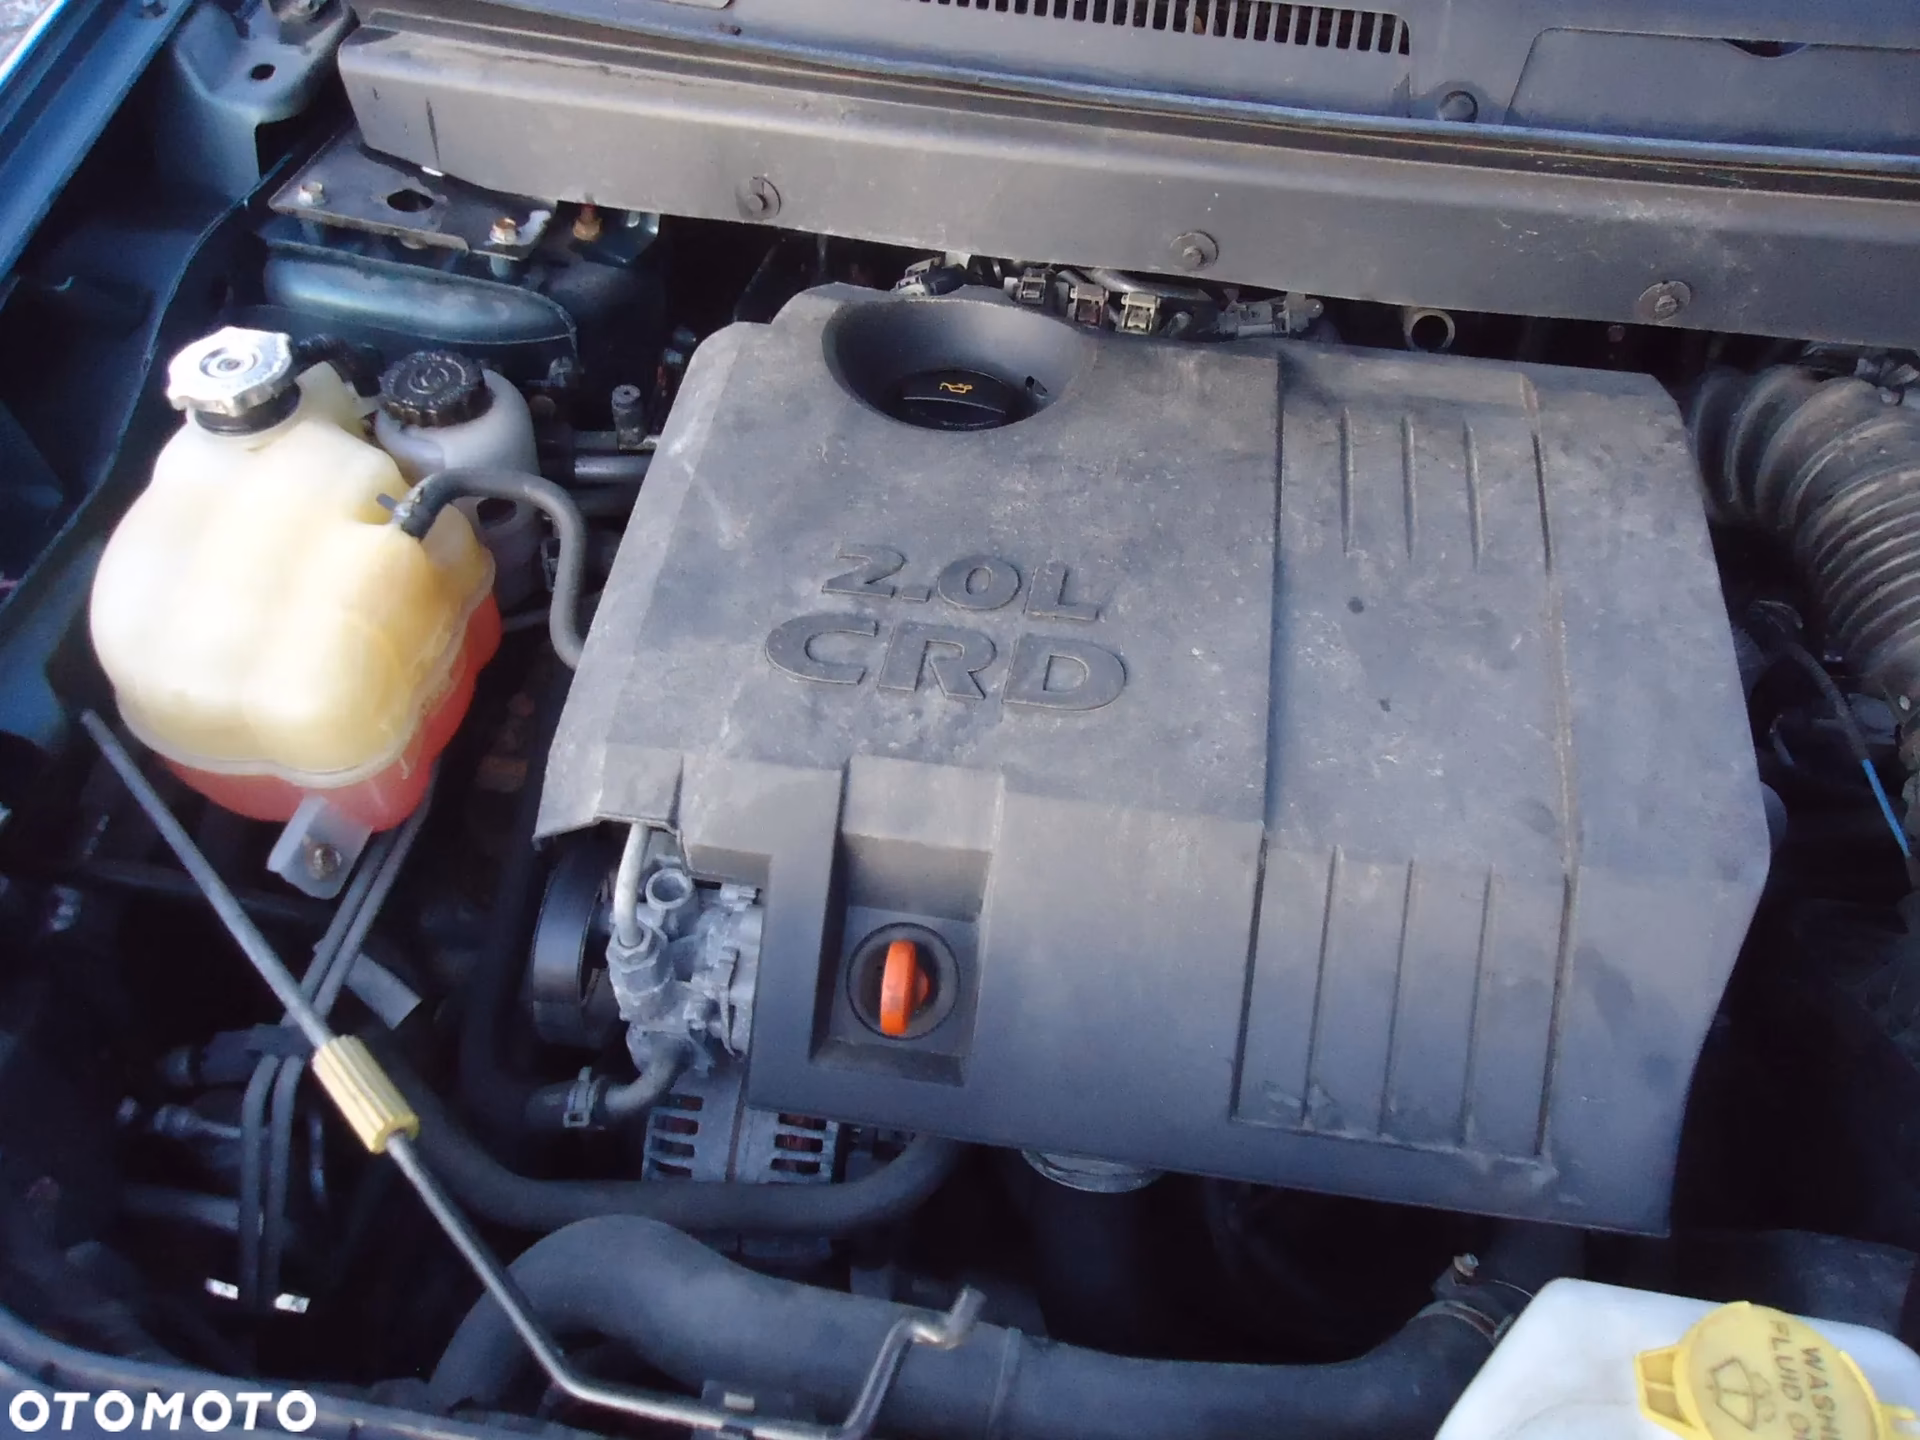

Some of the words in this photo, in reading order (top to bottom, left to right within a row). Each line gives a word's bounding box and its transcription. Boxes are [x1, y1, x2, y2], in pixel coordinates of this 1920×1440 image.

[821, 542, 1101, 622] 2.0L
[764, 612, 1128, 712] CRD
[1768, 1320, 1803, 1402] FLUID
[1786, 1411, 1813, 1440] O
[1800, 1347, 1843, 1440] WASH
